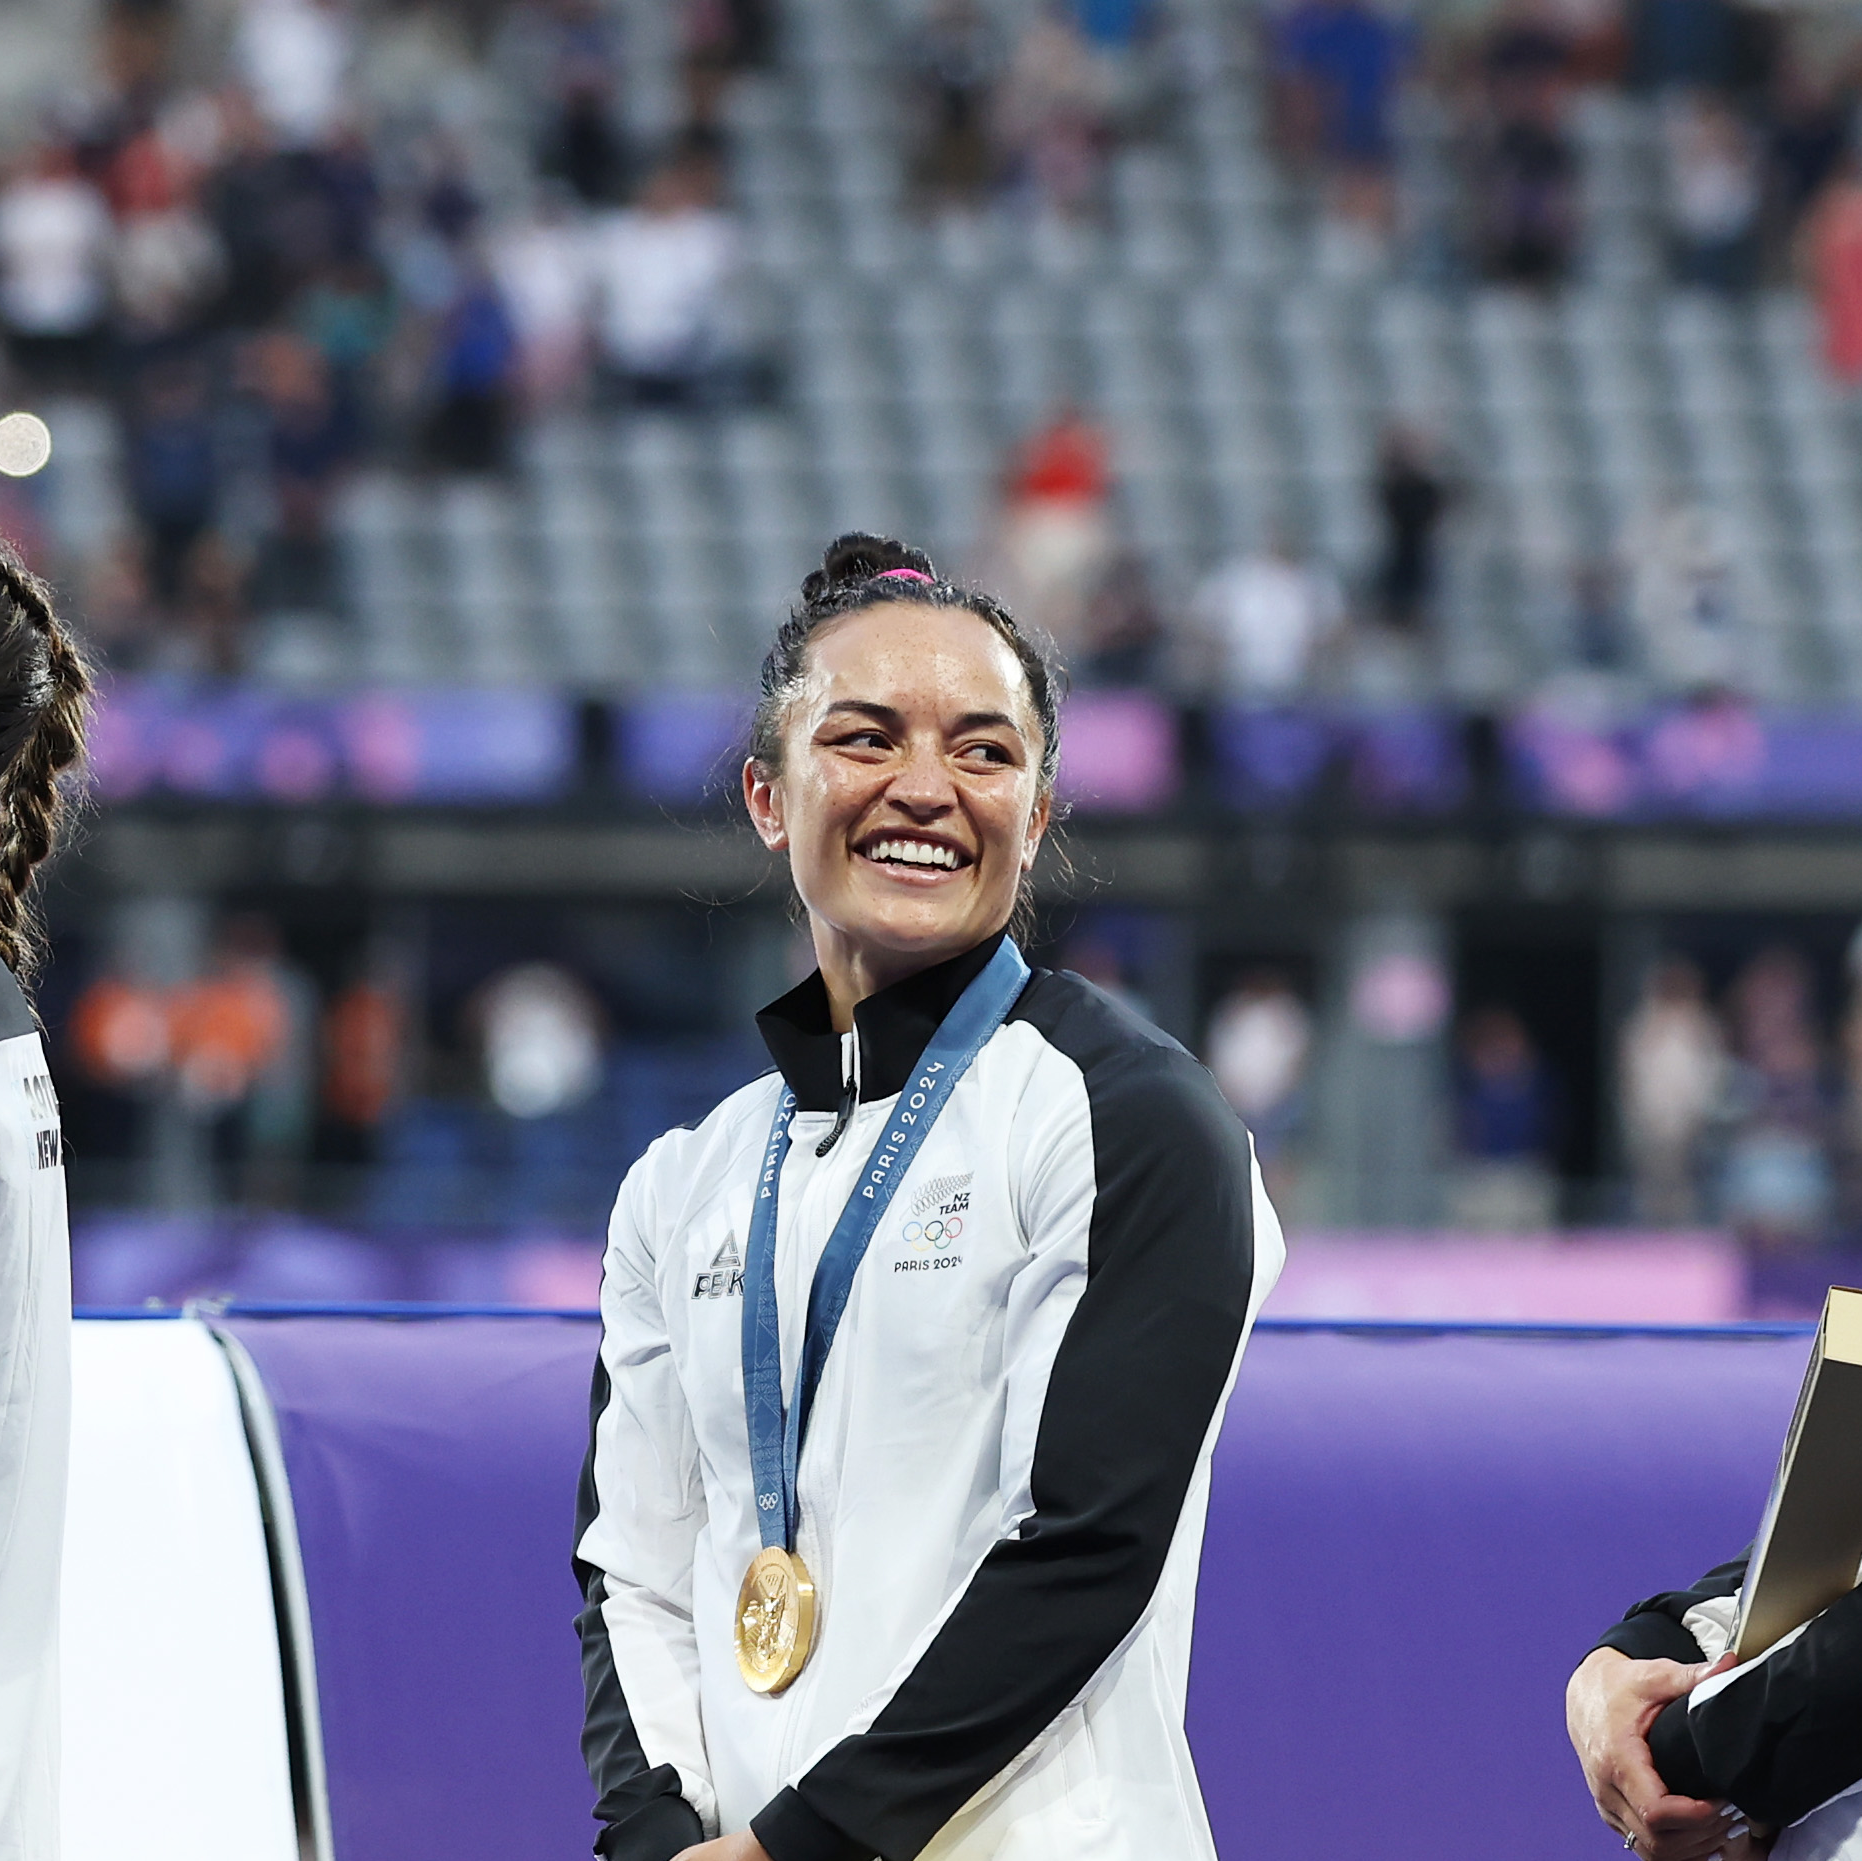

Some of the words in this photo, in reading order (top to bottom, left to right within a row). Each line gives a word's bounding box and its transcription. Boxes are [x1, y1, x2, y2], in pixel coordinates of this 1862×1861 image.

[860, 1130, 907, 1200] PARIS
[901, 1061, 945, 1127] 2024
[36, 1128, 59, 1170] NEW
[760, 1130, 785, 1199] PARIS
[939, 1202, 969, 1216] TEAM
[953, 1192, 971, 1203] NZ
[893, 1260, 930, 1273] PARIS
[932, 1255, 963, 1270] 2024
[691, 1268, 746, 1300] PEAK
